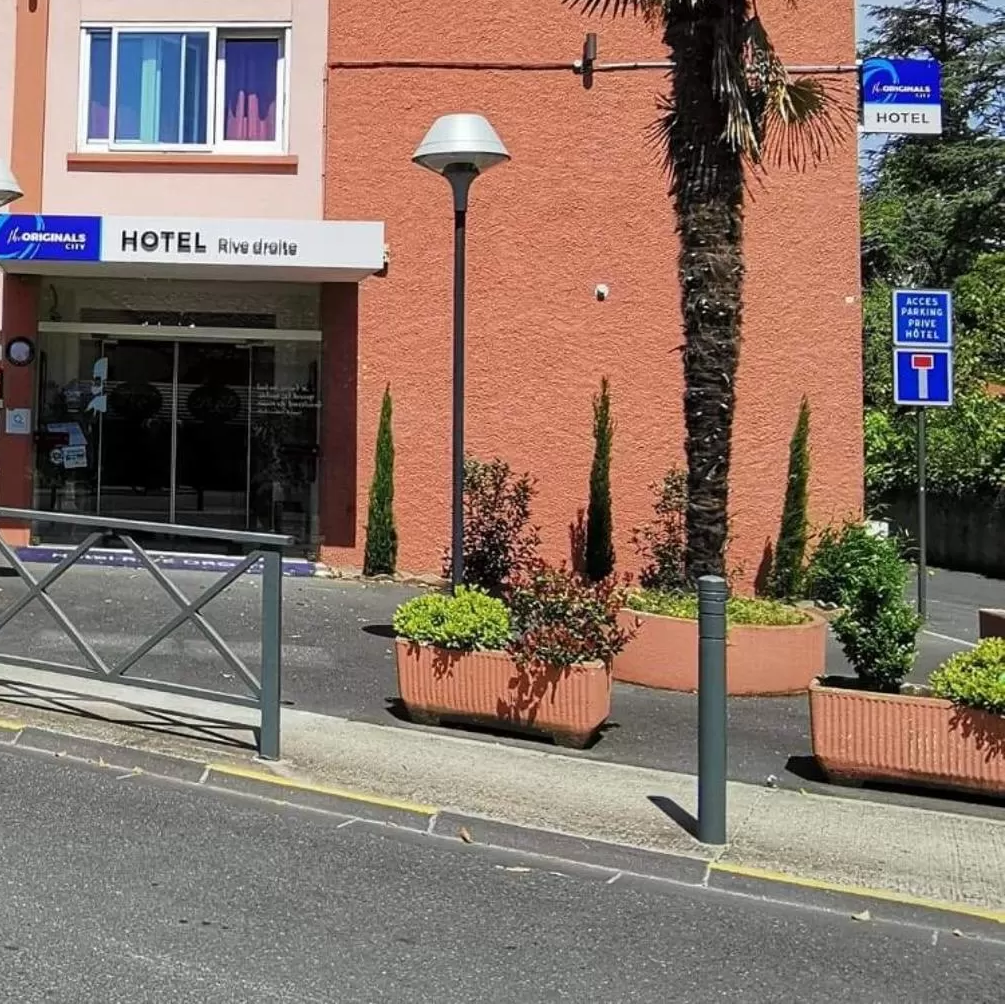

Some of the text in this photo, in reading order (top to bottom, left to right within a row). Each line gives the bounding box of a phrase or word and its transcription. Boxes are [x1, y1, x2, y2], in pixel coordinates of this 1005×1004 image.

[882, 85, 931, 93] ORIGINALS
[876, 112, 930, 124] HOTEL
[21, 232, 86, 243] ORIGINALS
[65, 243, 86, 251] CITY
[121, 230, 298, 257] HOTEL Rive droite
[906, 297, 939, 306] ACCES
[901, 307, 943, 317] PARKING
[908, 318, 937, 328] PRIVE
[905, 329, 940, 340] HÔTEL
